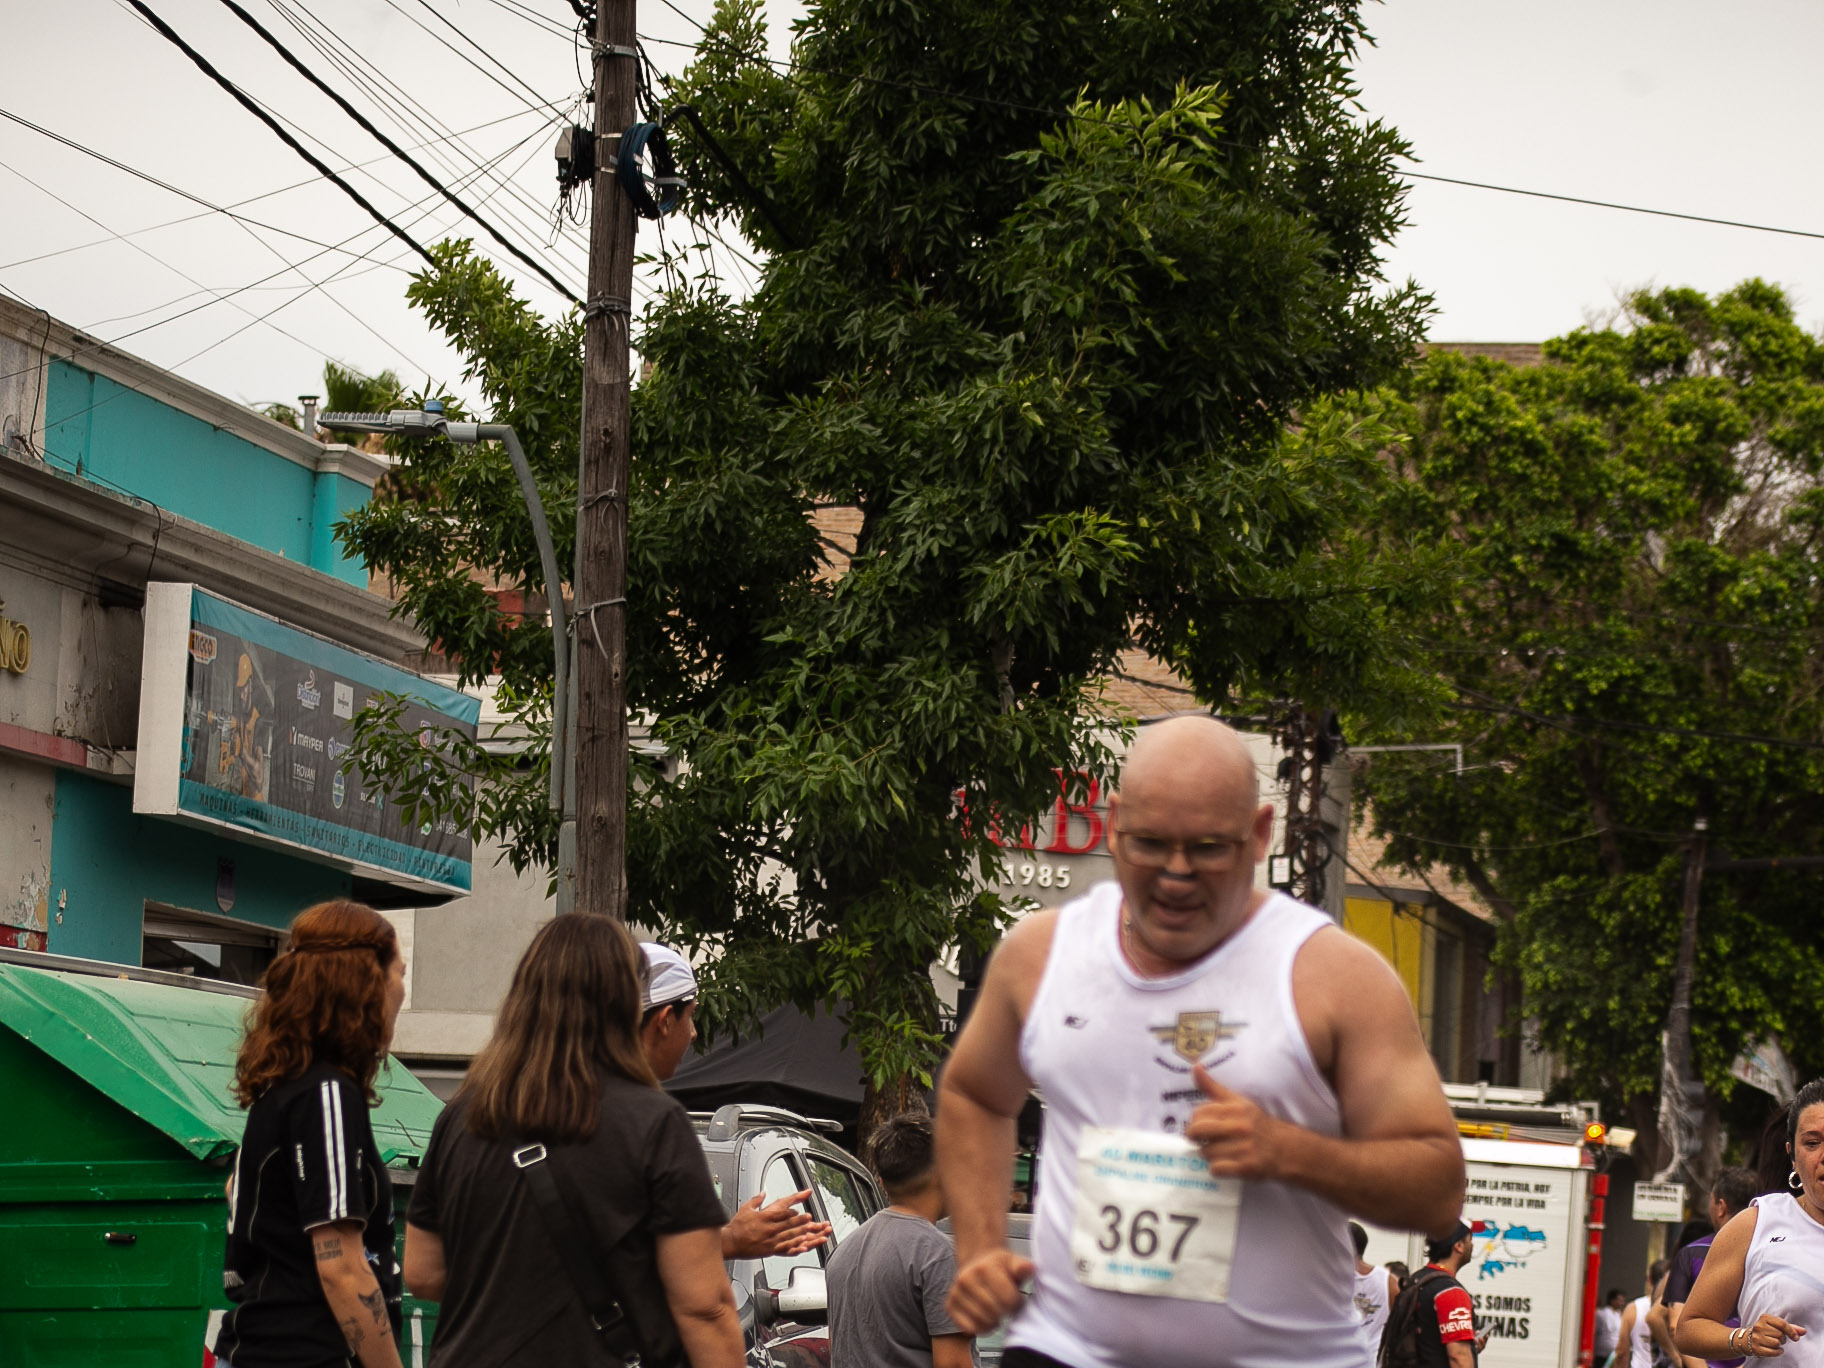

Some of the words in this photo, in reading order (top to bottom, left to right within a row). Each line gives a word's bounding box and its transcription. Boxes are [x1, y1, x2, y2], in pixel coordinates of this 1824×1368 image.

[1002, 862, 1071, 889] 1985
[1496, 1197, 1512, 1207] POR
[1526, 1199, 1546, 1209] VIDA
[1098, 1205, 1200, 1263] 367
[1486, 1295, 1531, 1312] SOMOS
